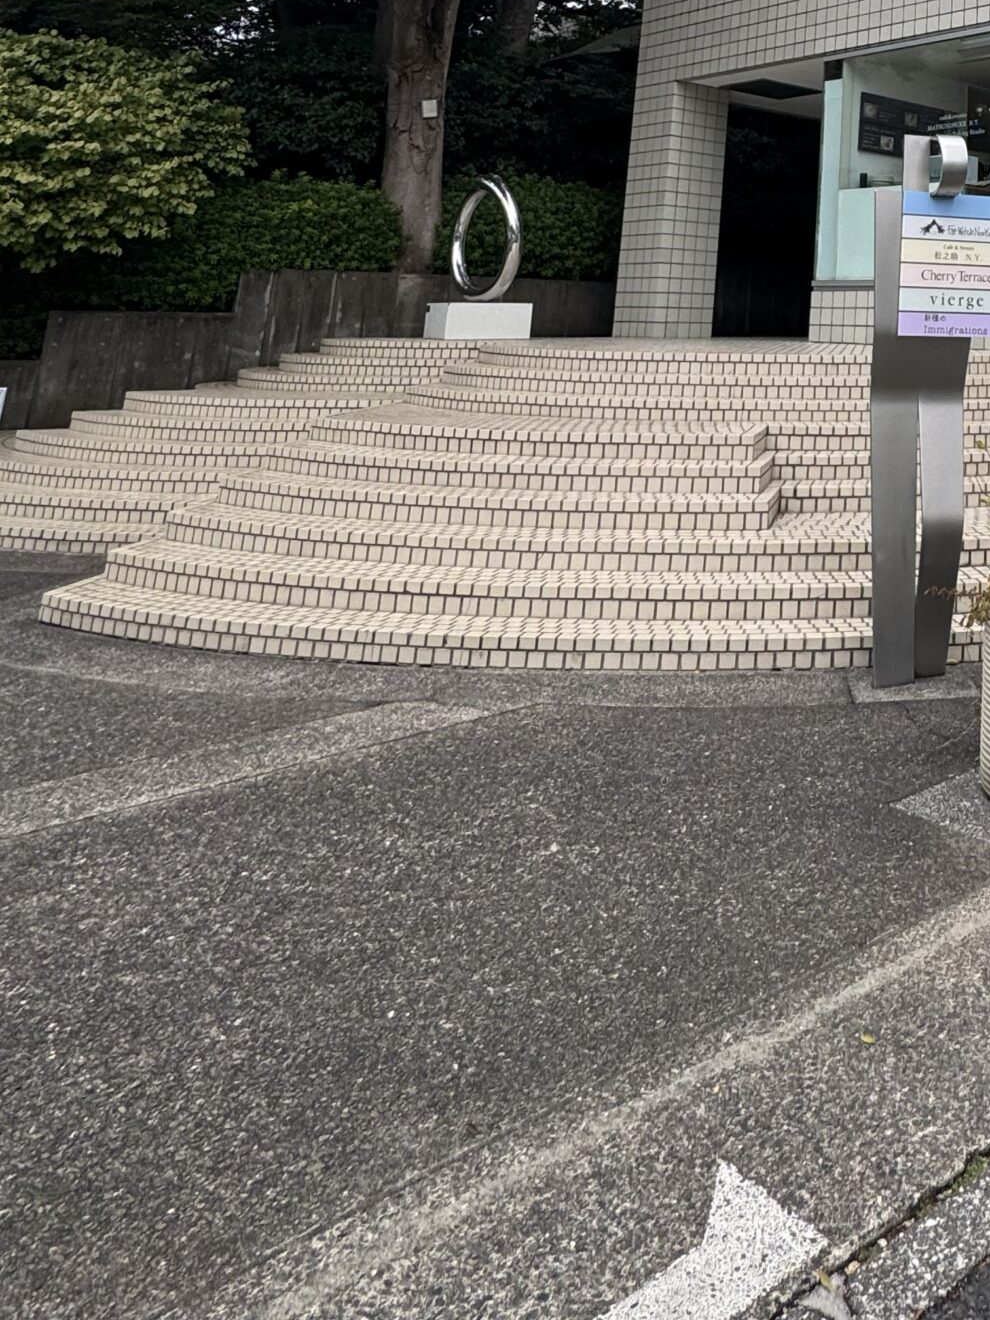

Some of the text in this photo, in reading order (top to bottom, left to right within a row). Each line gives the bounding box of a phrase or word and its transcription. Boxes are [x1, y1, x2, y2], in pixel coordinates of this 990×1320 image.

[934, 251, 959, 261] 松之助
[921, 268, 958, 285] Cherry
[930, 293, 984, 309] vierge
[923, 324, 988, 336] Immigrations
